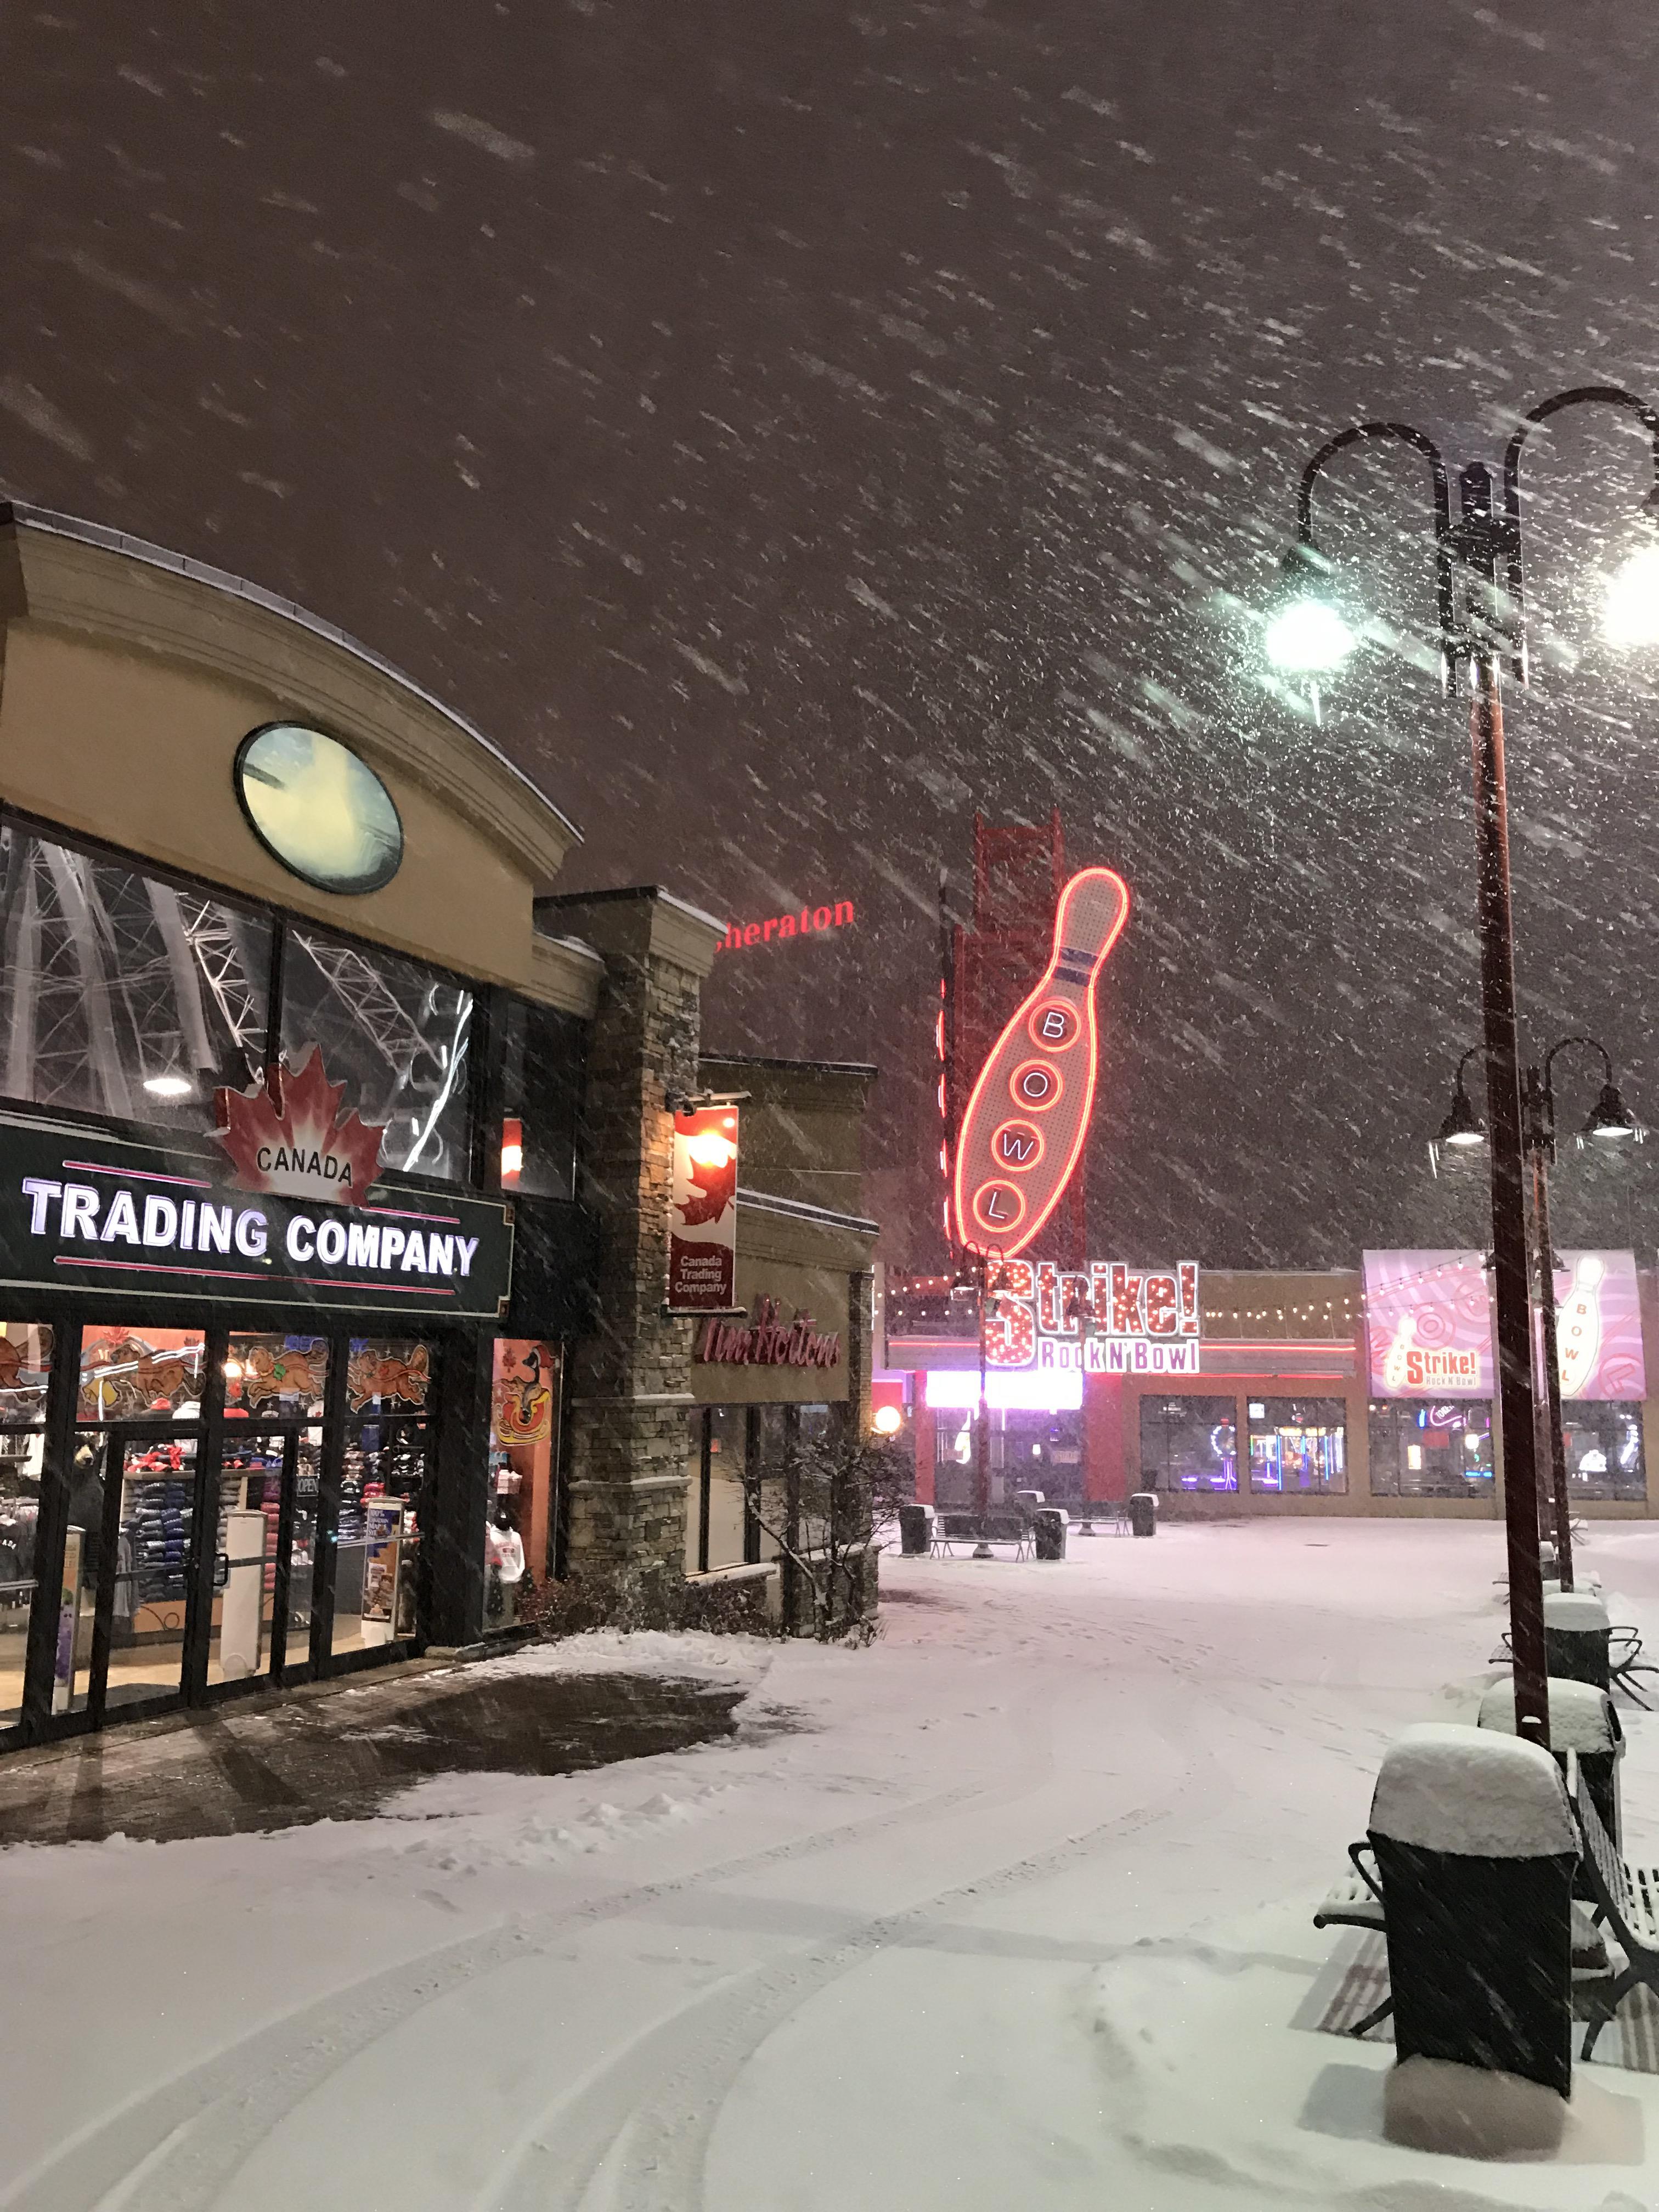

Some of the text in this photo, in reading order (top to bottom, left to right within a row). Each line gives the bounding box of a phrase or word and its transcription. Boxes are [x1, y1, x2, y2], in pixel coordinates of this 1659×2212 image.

[714, 900, 855, 953] heraton
[256, 1146, 353, 1188] CANADA
[22, 1177, 479, 1277] TRADING COMPANY
[680, 1255, 722, 1267] Canada
[680, 1268, 722, 1282] Trading
[675, 1281, 727, 1295] Company
[985, 1259, 1200, 1367] Strike!
[1133, 1340, 1198, 1371] Bowl
[1406, 1351, 1476, 1384] Strike!
[1426, 1376, 1445, 1385] Rock
[1457, 1376, 1476, 1386] Bowl
[298, 1479, 317, 1492] OPEN
